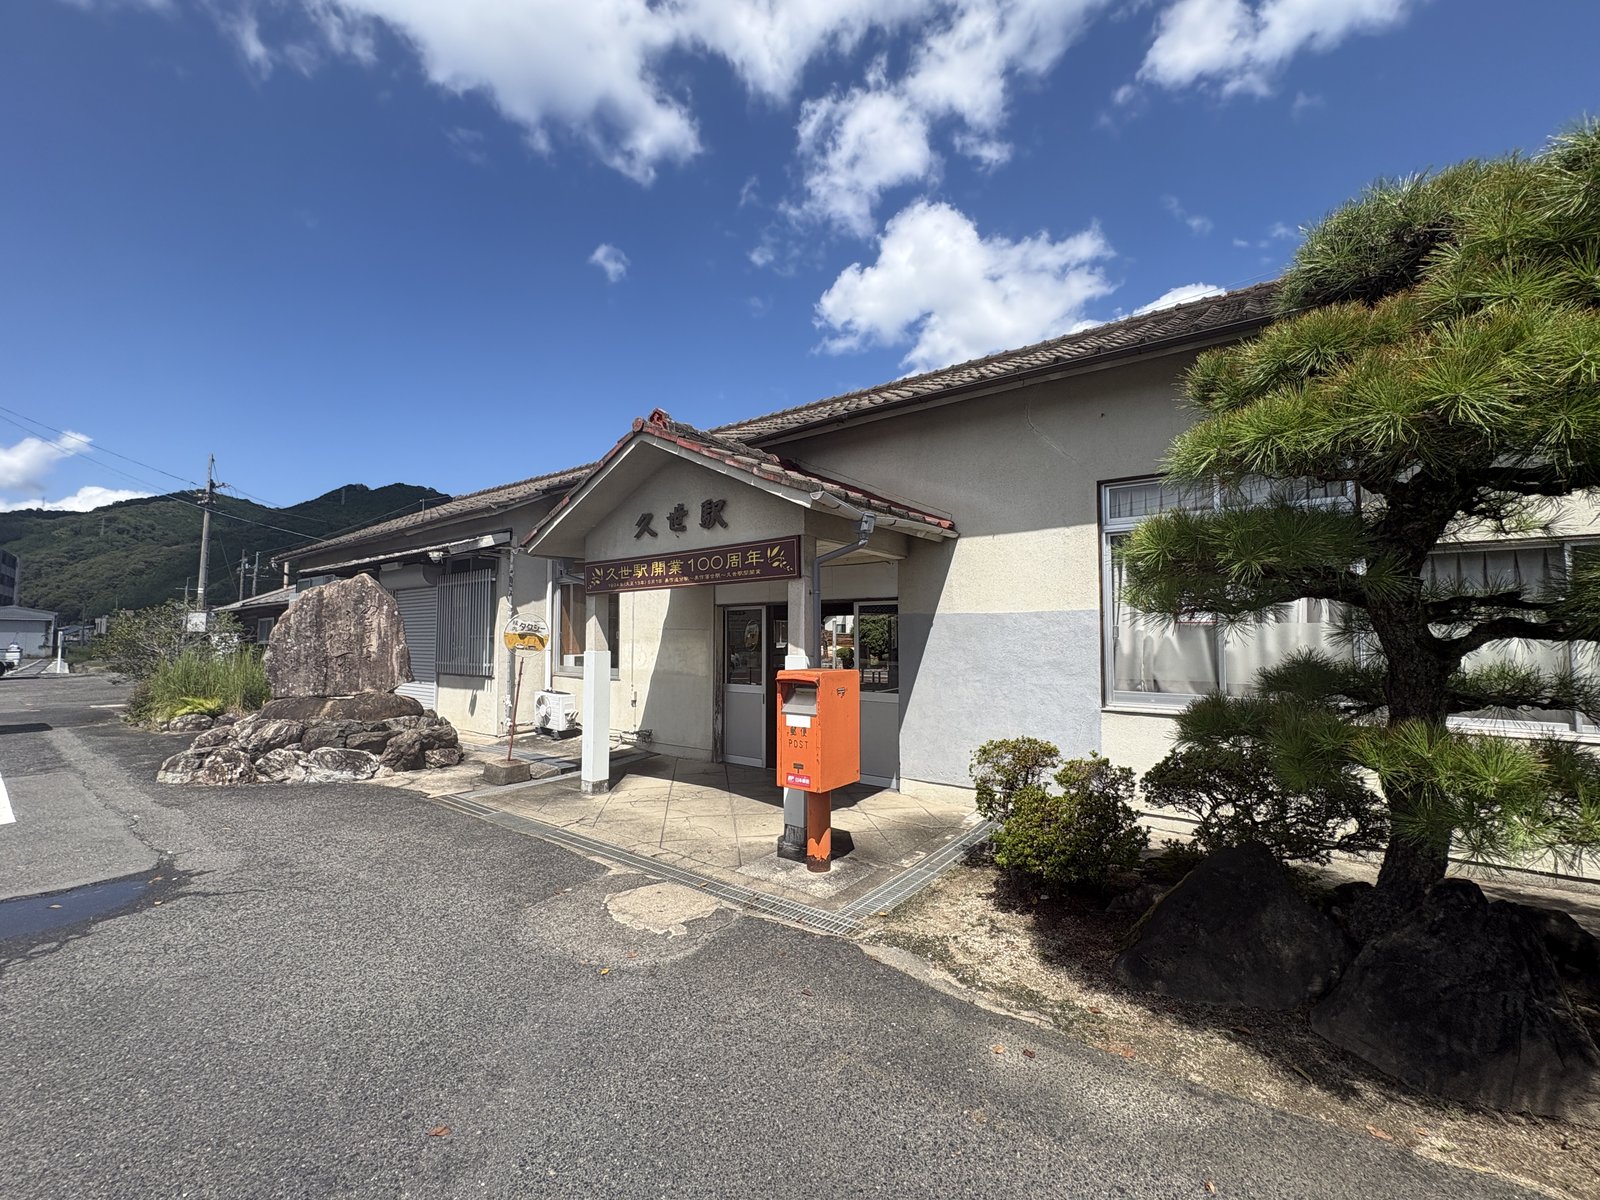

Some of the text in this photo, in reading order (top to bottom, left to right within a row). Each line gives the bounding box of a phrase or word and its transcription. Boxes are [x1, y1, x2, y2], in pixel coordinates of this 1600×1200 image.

[634, 499, 728, 540] 久世駅
[606, 550, 764, 581] 久世駅開業100周年
[790, 726, 808, 737] 郵便
[788, 738, 808, 749] POST
